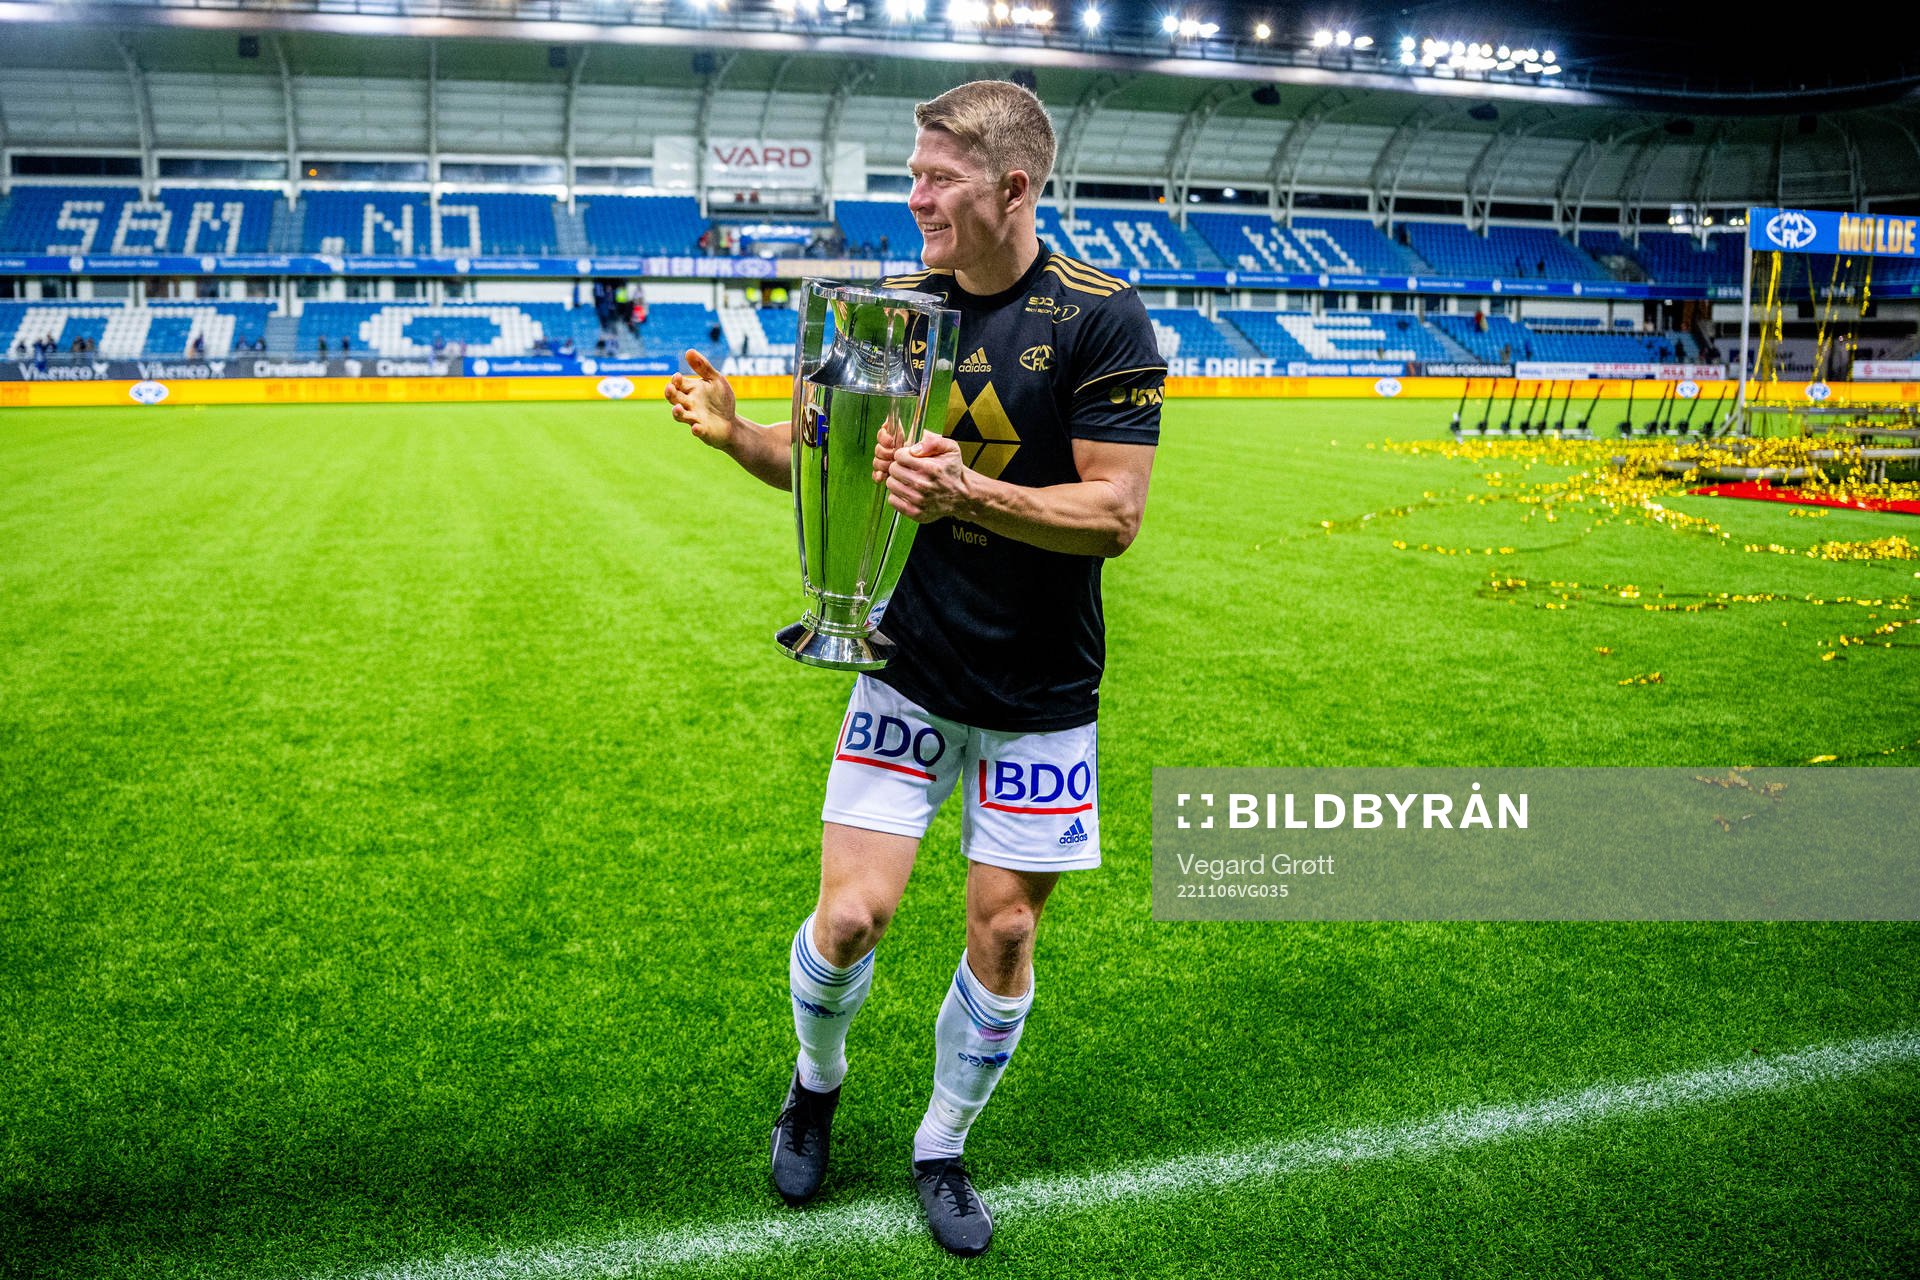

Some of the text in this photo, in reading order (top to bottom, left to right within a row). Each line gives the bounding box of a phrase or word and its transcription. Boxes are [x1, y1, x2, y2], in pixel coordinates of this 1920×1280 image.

[713, 146, 811, 168] VARD
[1838, 215, 1916, 254] MOLDE
[720, 356, 785, 375] AKER
[958, 363, 991, 373] adidas
[1205, 358, 1276, 377] DRIFT
[952, 524, 988, 546] Møre
[845, 711, 946, 768] BDO
[994, 760, 1091, 803] BDO
[1059, 832, 1088, 844] adidas
